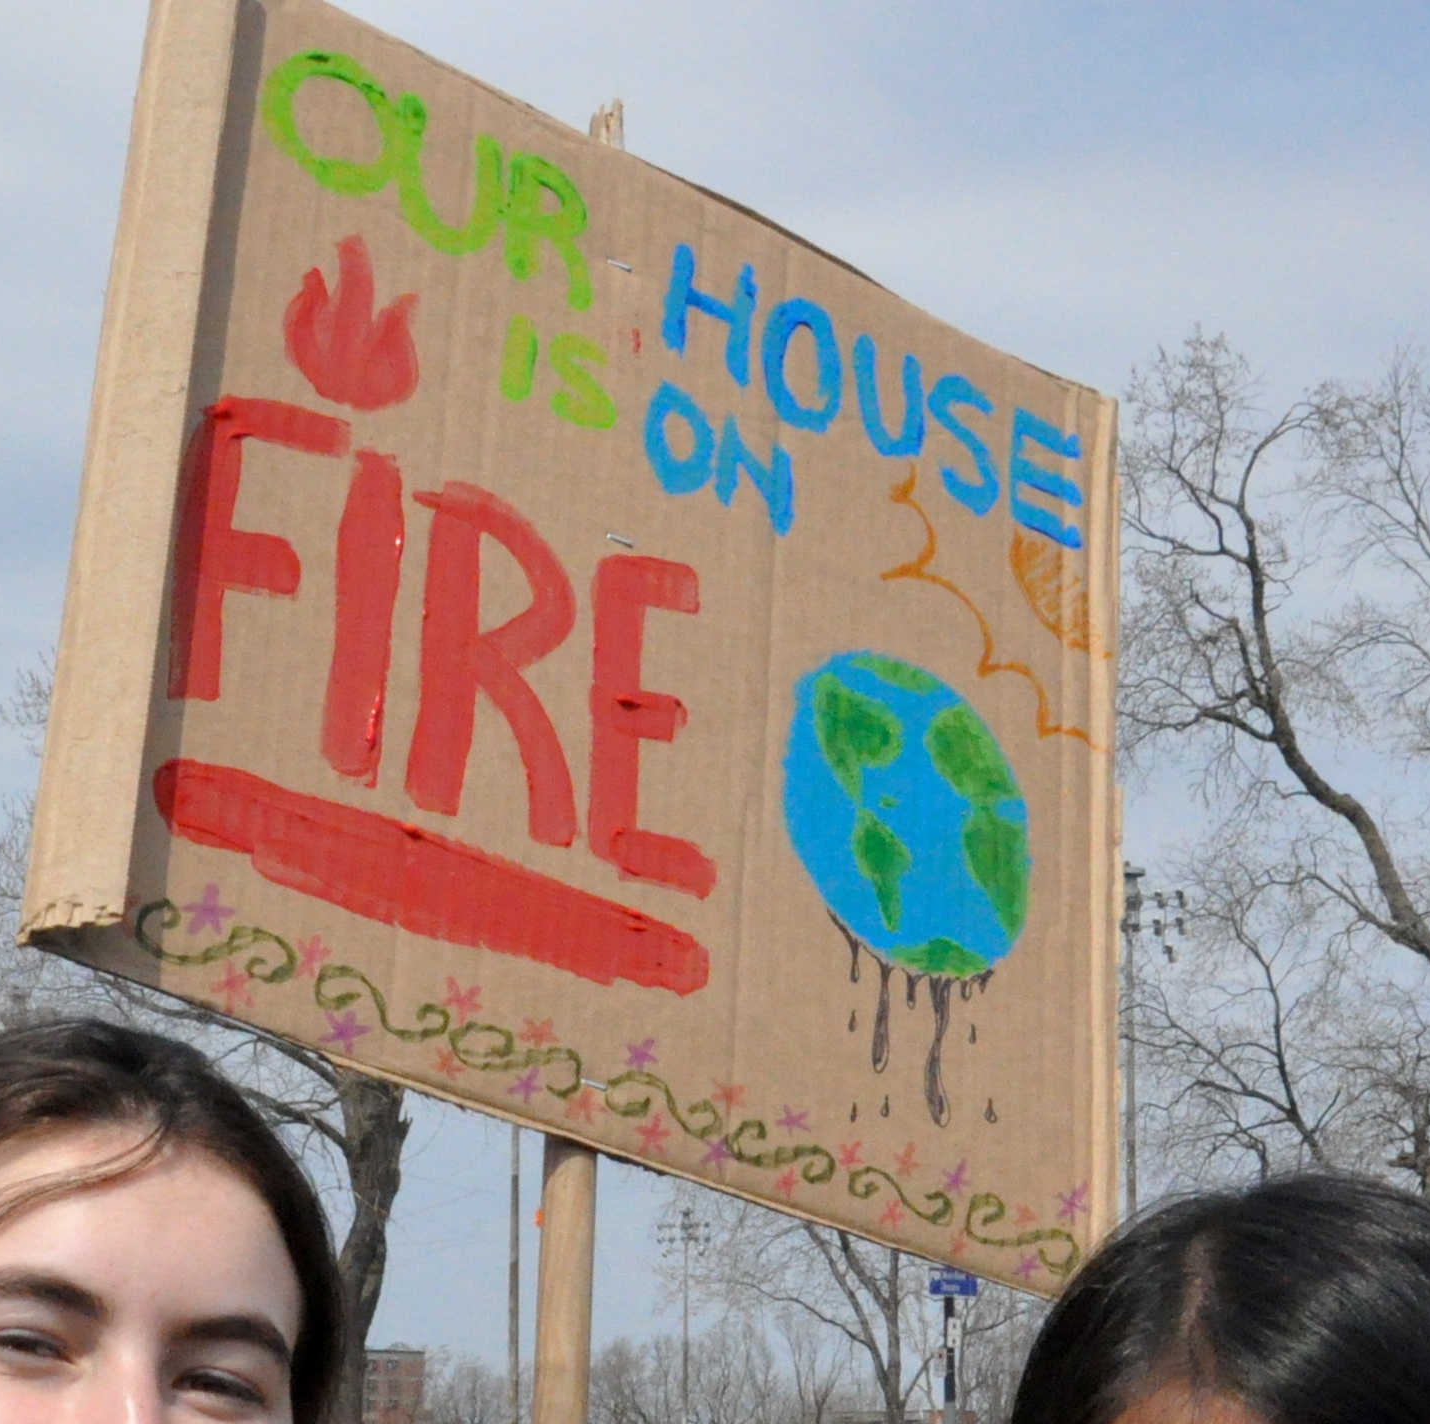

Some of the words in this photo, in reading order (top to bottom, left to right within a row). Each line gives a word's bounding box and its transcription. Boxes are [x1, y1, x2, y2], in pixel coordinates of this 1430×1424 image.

[259, 47, 594, 312] OUR
[498, 314, 618, 431] IS
[644, 380, 795, 536] ON
[661, 244, 1084, 549] HOUSE
[168, 395, 718, 899] FIRE
